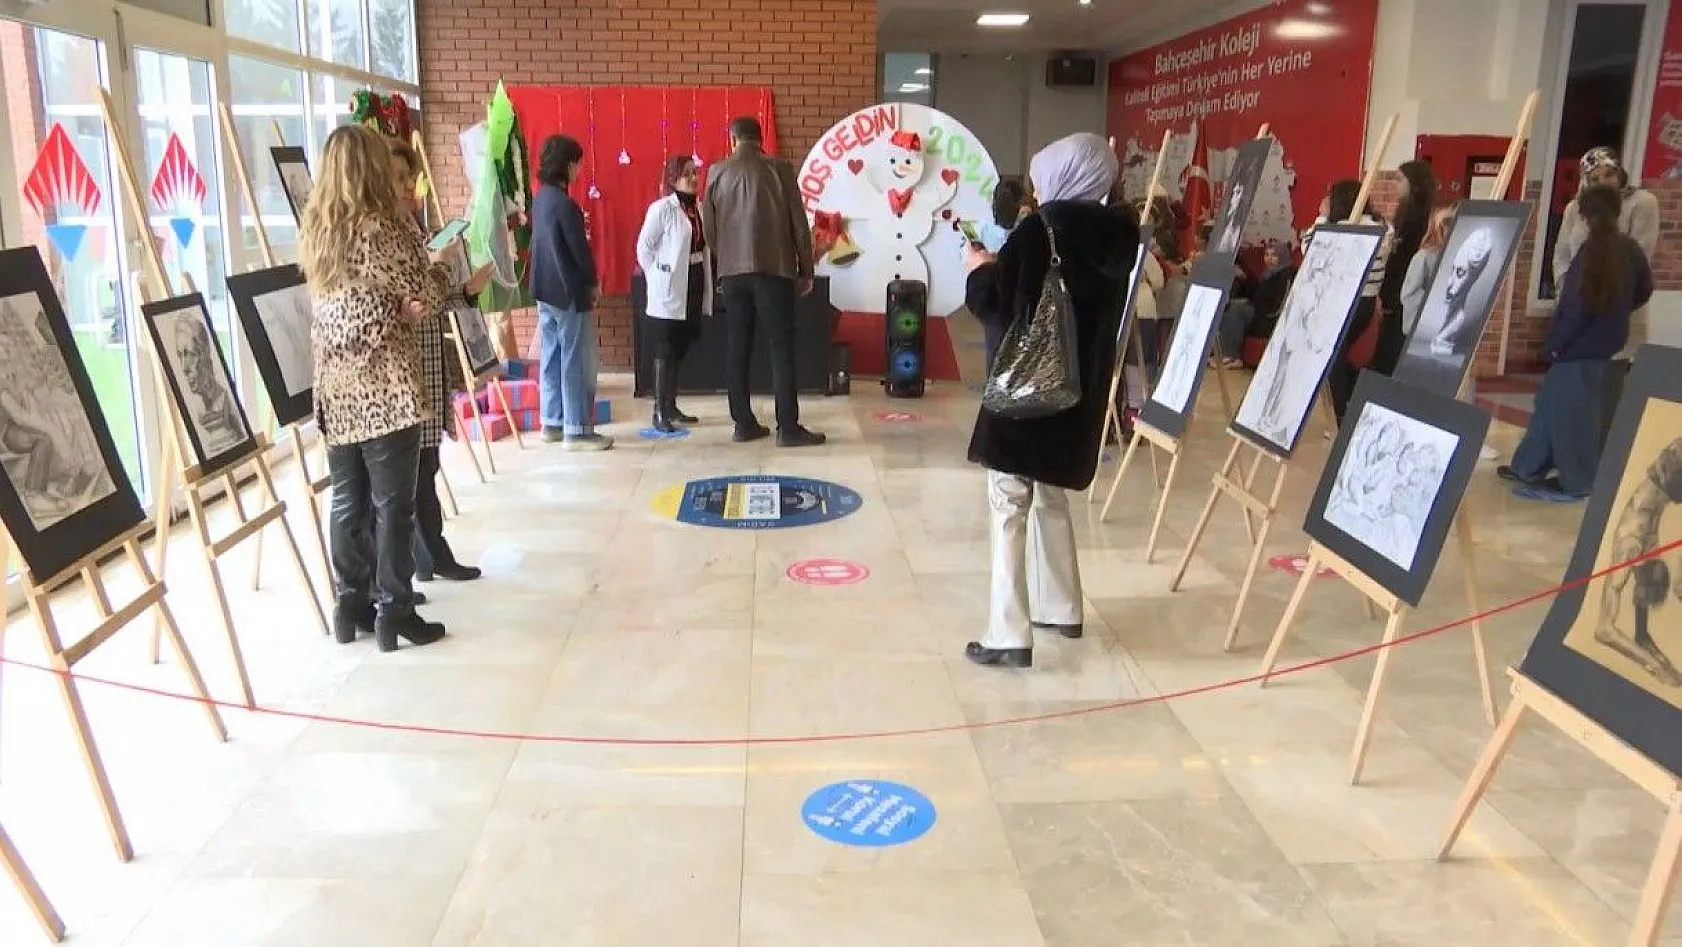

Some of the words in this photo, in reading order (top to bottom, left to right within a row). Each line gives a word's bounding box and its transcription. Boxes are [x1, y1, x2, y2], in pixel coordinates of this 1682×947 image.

[1155, 38, 1216, 76] Bahçeşehir
[1219, 21, 1261, 58] Koleji
[1182, 66, 1238, 95] Türkiye'nin
[1241, 61, 1264, 82] Her
[1267, 48, 1312, 76] Yerine
[1223, 90, 1261, 115] Ediyor
